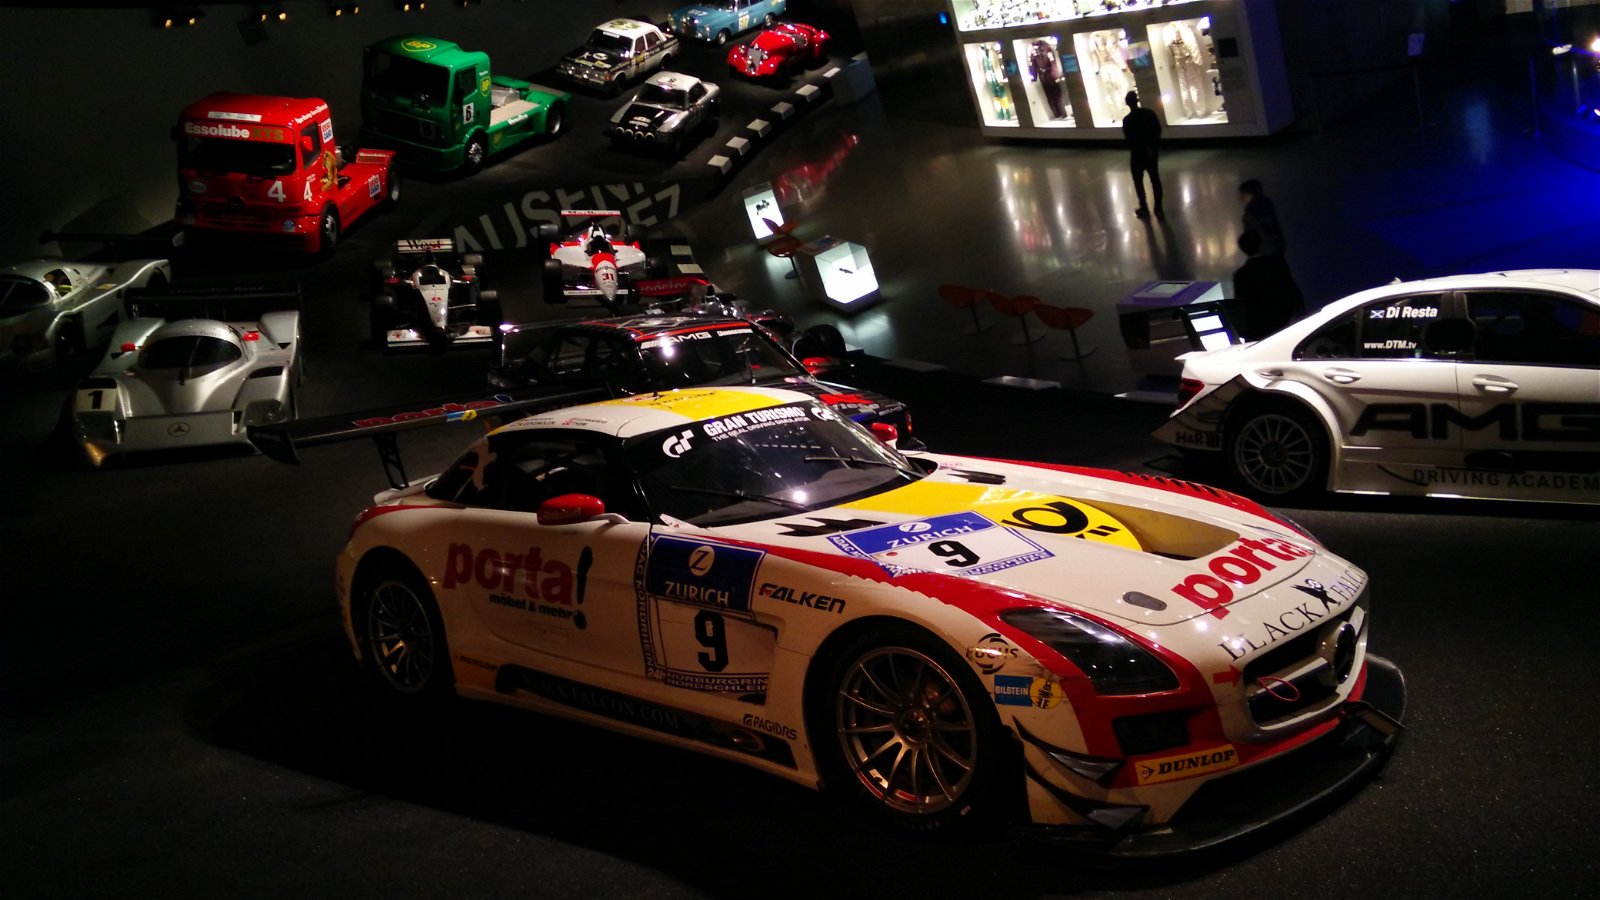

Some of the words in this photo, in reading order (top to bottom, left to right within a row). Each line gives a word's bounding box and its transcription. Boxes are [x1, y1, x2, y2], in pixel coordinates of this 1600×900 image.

[465, 105, 472, 121] 6
[184, 121, 250, 138] Essolube
[251, 127, 285, 141] XTS
[267, 180, 287, 203] 4
[303, 181, 313, 202] 4
[602, 272, 615, 281] 31
[1386, 306, 1400, 318] Di
[1402, 306, 1438, 318] Resta
[1364, 340, 1417, 349] www.DTM.tv
[88, 390, 103, 410] 1
[703, 415, 748, 437] GRAN
[745, 406, 805, 424] TURISMO
[1350, 402, 1600, 441] AMG
[711, 432, 729, 443] THE
[729, 426, 748, 437] REAL
[1413, 469, 1500, 487] DRIVING
[887, 525, 973, 549] ZURICH
[928, 540, 981, 568] 9
[442, 543, 593, 630] porta!
[1171, 537, 1314, 621] porta
[663, 580, 730, 607] ZURICH
[758, 583, 846, 614] FALKEN
[489, 593, 526, 609] möbel
[527, 601, 537, 612] &
[538, 604, 573, 619] mehr
[694, 610, 729, 672] 9
[995, 685, 1029, 696] BILSTEIN
[1158, 749, 1235, 775] DUNLOP
